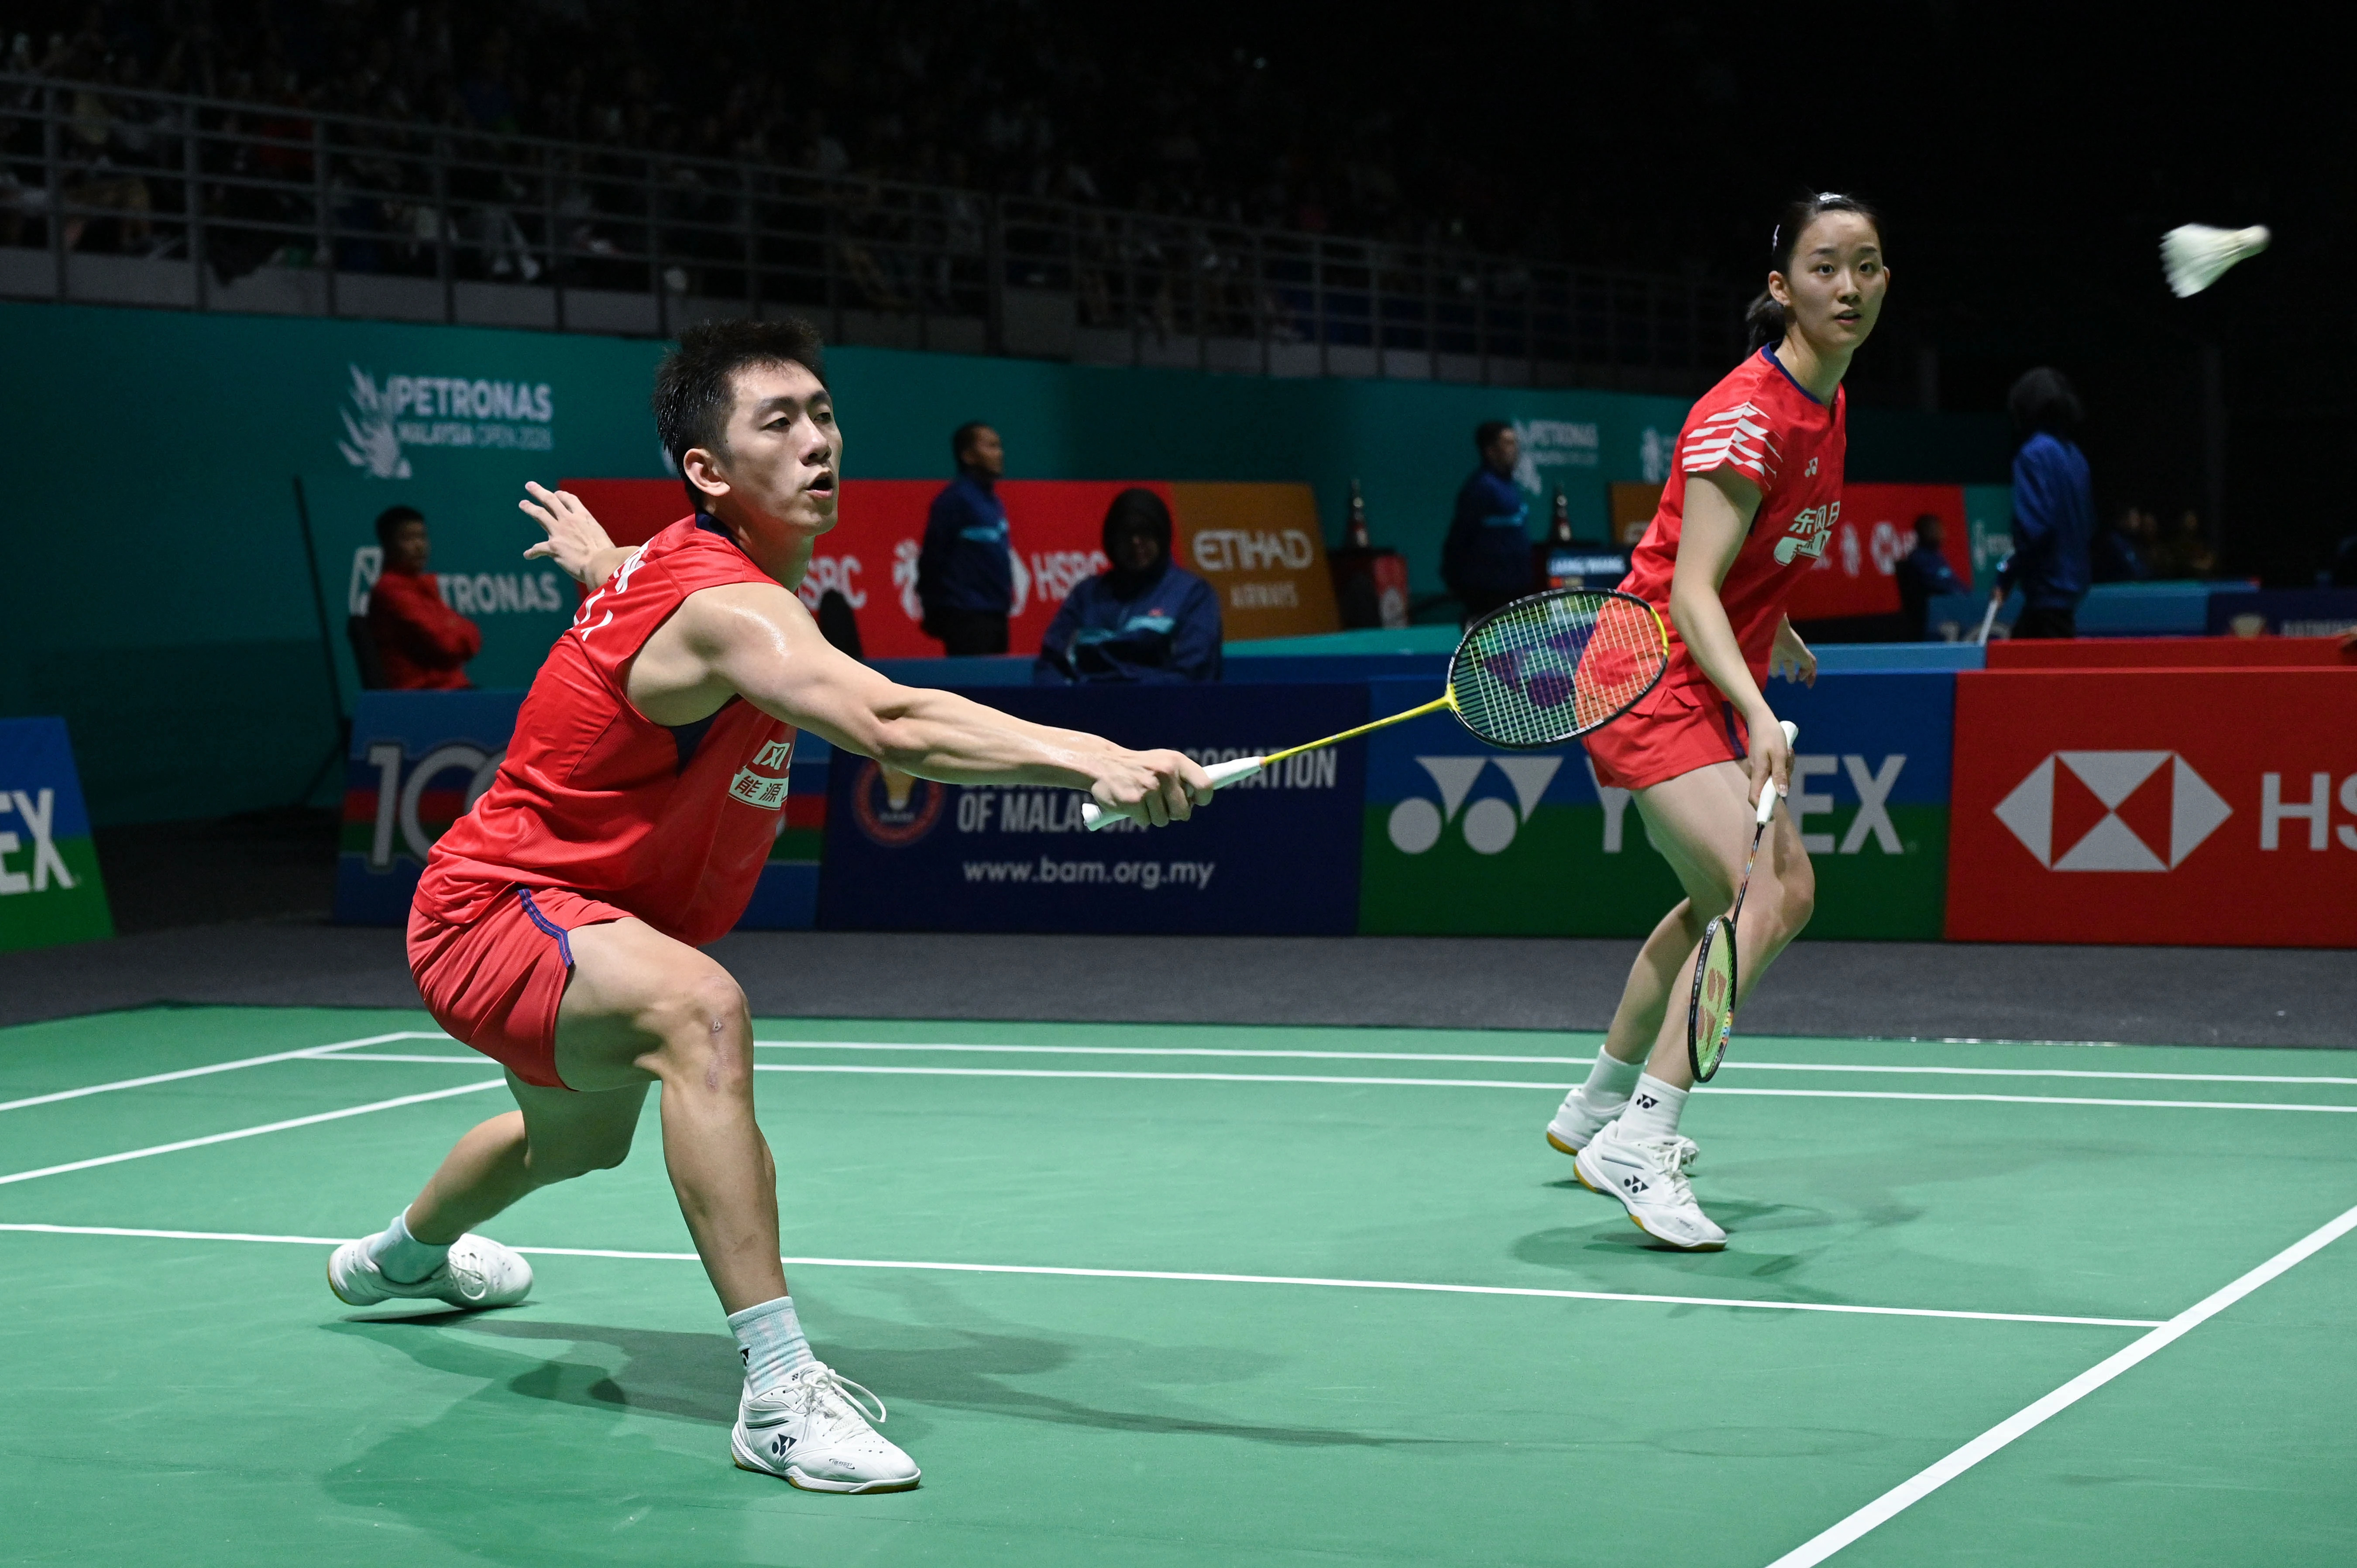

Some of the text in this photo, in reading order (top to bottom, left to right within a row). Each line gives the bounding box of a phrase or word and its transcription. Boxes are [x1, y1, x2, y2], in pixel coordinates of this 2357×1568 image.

[391, 376, 553, 422] PETRONAS
[1192, 528, 1313, 571] ETIHAD
[437, 571, 563, 614] TRONAS
[798, 556, 867, 610] SBC
[1181, 747, 1338, 789] CIATION
[958, 792, 995, 833] OF
[1584, 753, 1907, 854] YEX
[962, 854, 1216, 890] www.bam.org.my
